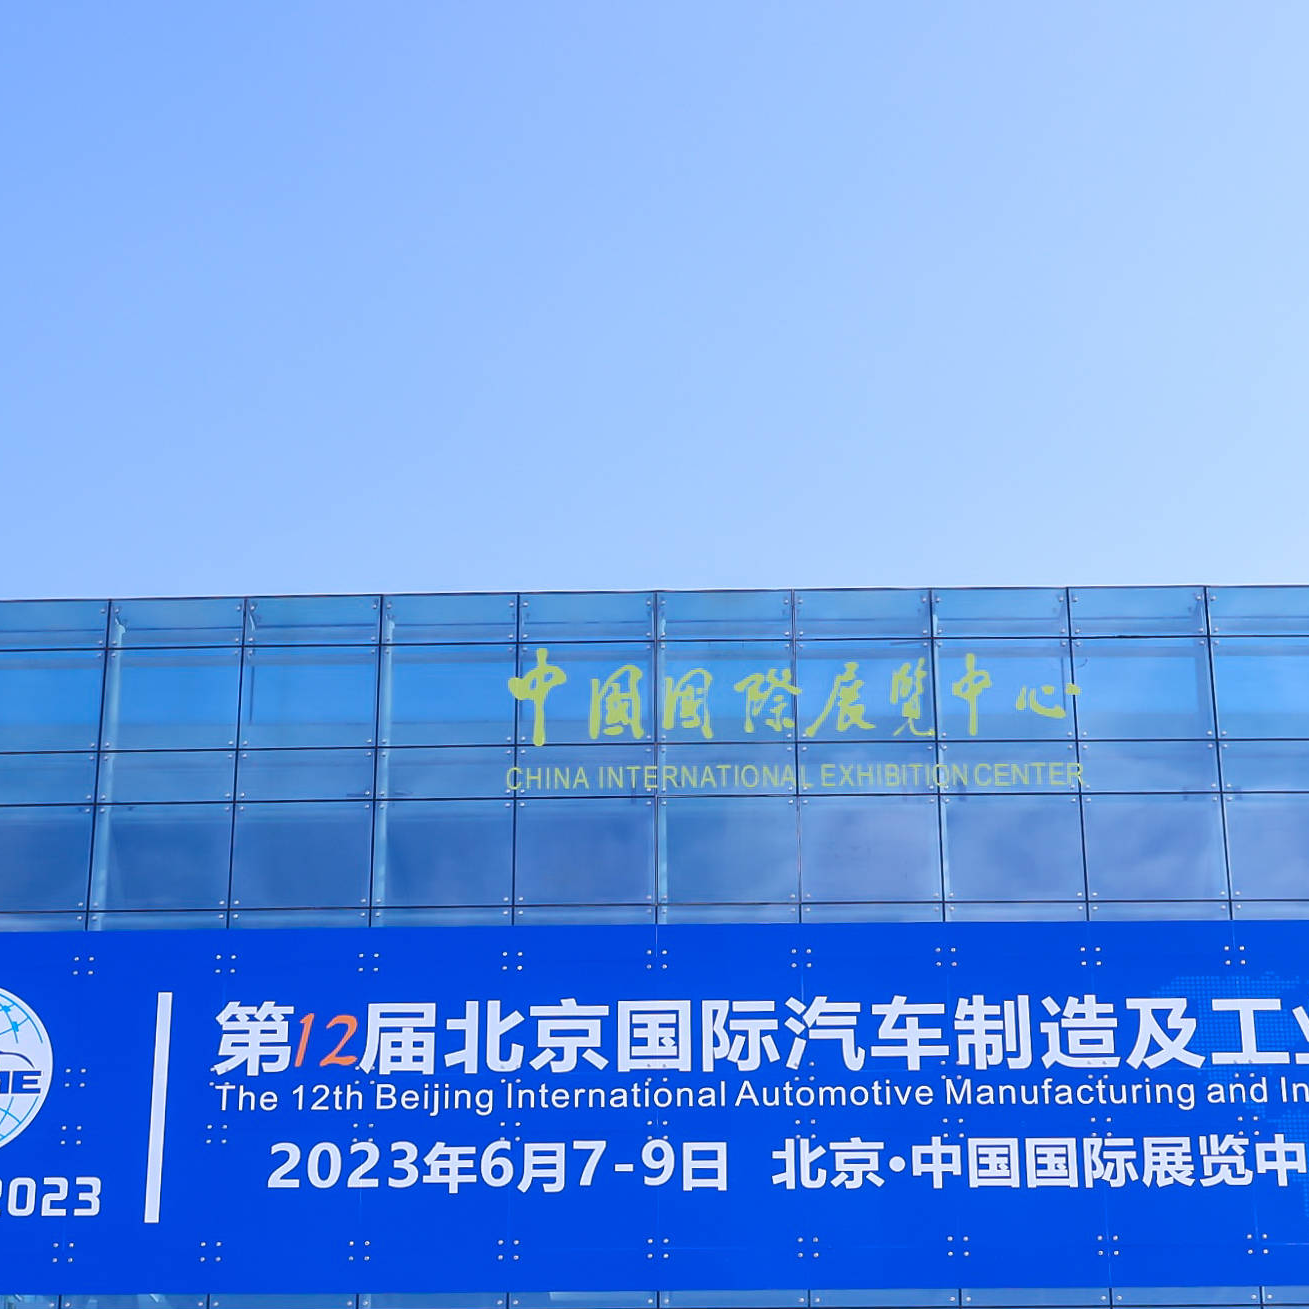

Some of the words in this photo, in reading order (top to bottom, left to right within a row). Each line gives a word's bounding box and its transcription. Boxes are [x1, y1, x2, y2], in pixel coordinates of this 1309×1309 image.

[506, 767, 589, 790] CHINA
[599, 764, 813, 790] INTERNATIONAL
[821, 763, 968, 788] EXHIBITION
[974, 762, 1085, 787] CENTER
[214, 1085, 278, 1111] The
[292, 1083, 364, 1111] 12th
[376, 1082, 494, 1116] Beijing
[506, 1080, 726, 1109] International
[734, 1078, 934, 1107] Automotive
[945, 1077, 1196, 1110] Manufacturing
[1206, 1076, 1268, 1104] and
[268, 1136, 728, 1194] 2023年6月7-9日
